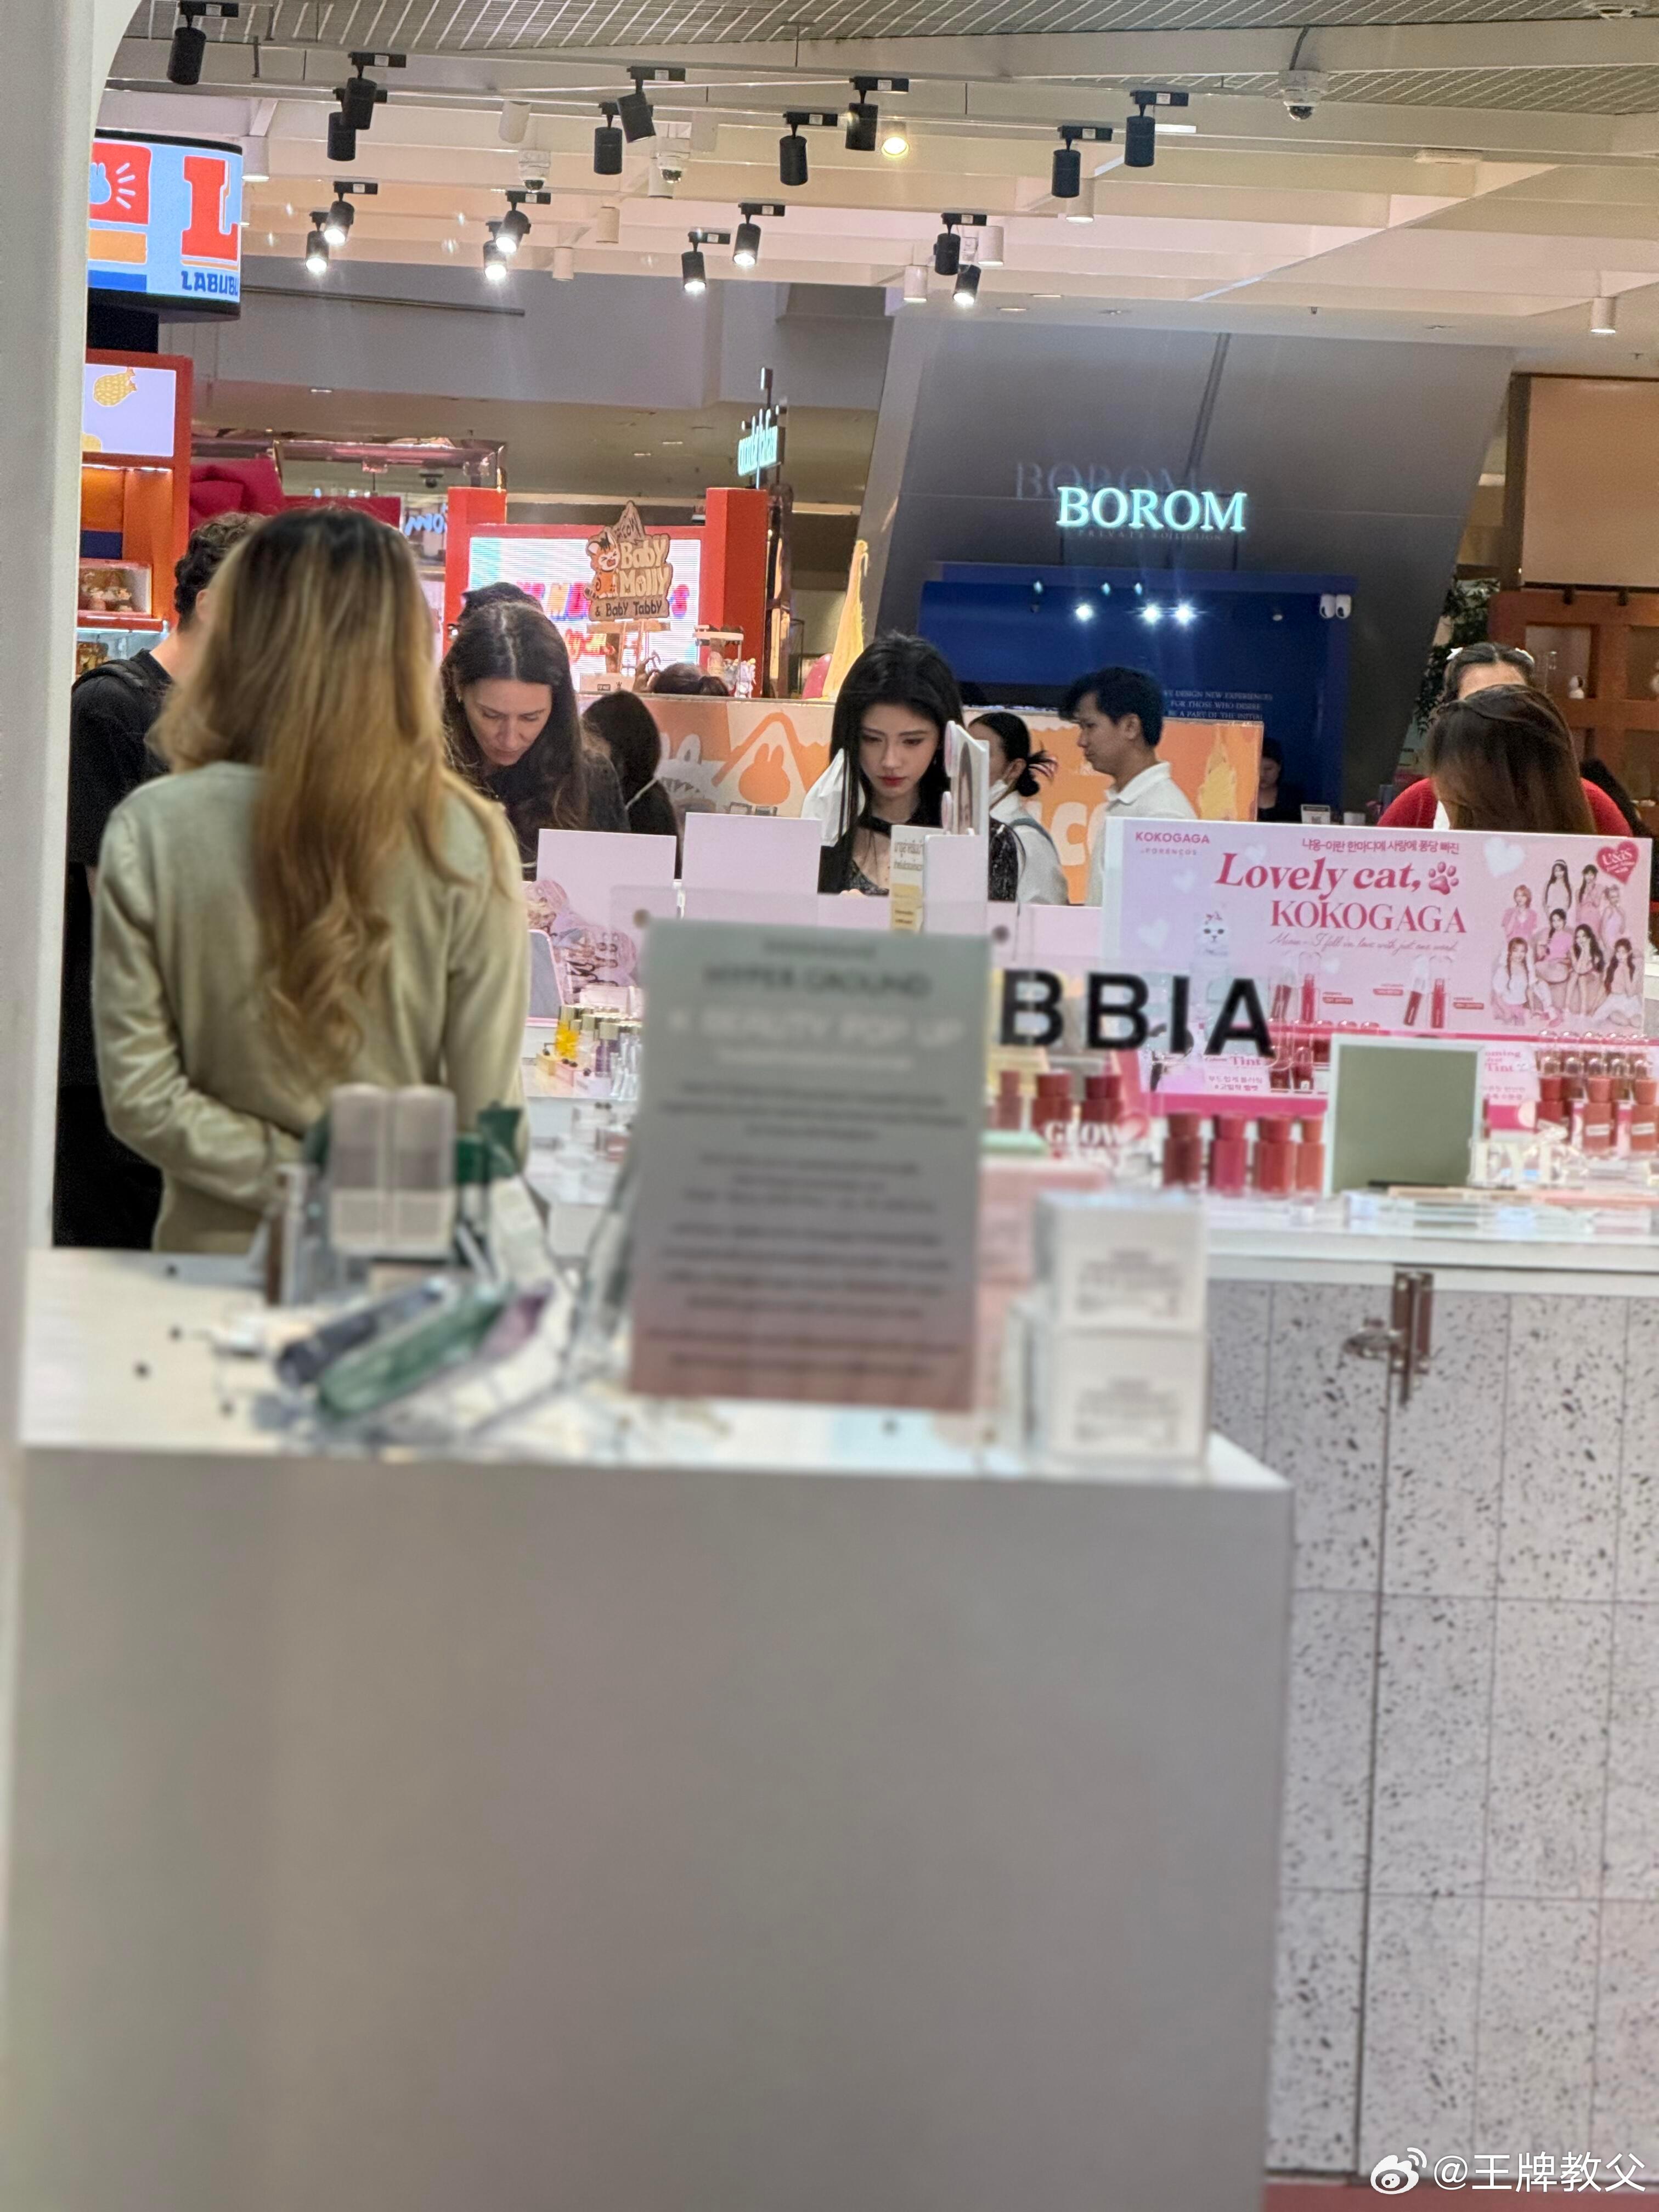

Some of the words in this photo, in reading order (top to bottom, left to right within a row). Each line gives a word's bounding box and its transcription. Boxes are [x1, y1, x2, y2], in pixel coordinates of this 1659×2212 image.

[1056, 486, 1248, 531] BOROM
[1135, 831, 1210, 844] KOKOGAGA
[1347, 840, 1386, 853] 한마디에
[1387, 840, 1418, 853] 사랑에
[1215, 852, 1348, 901] Lovely
[1353, 862, 1421, 893] cat,
[1269, 899, 1467, 933] KOKOGAGA
[999, 969, 1277, 1058] BBIA
